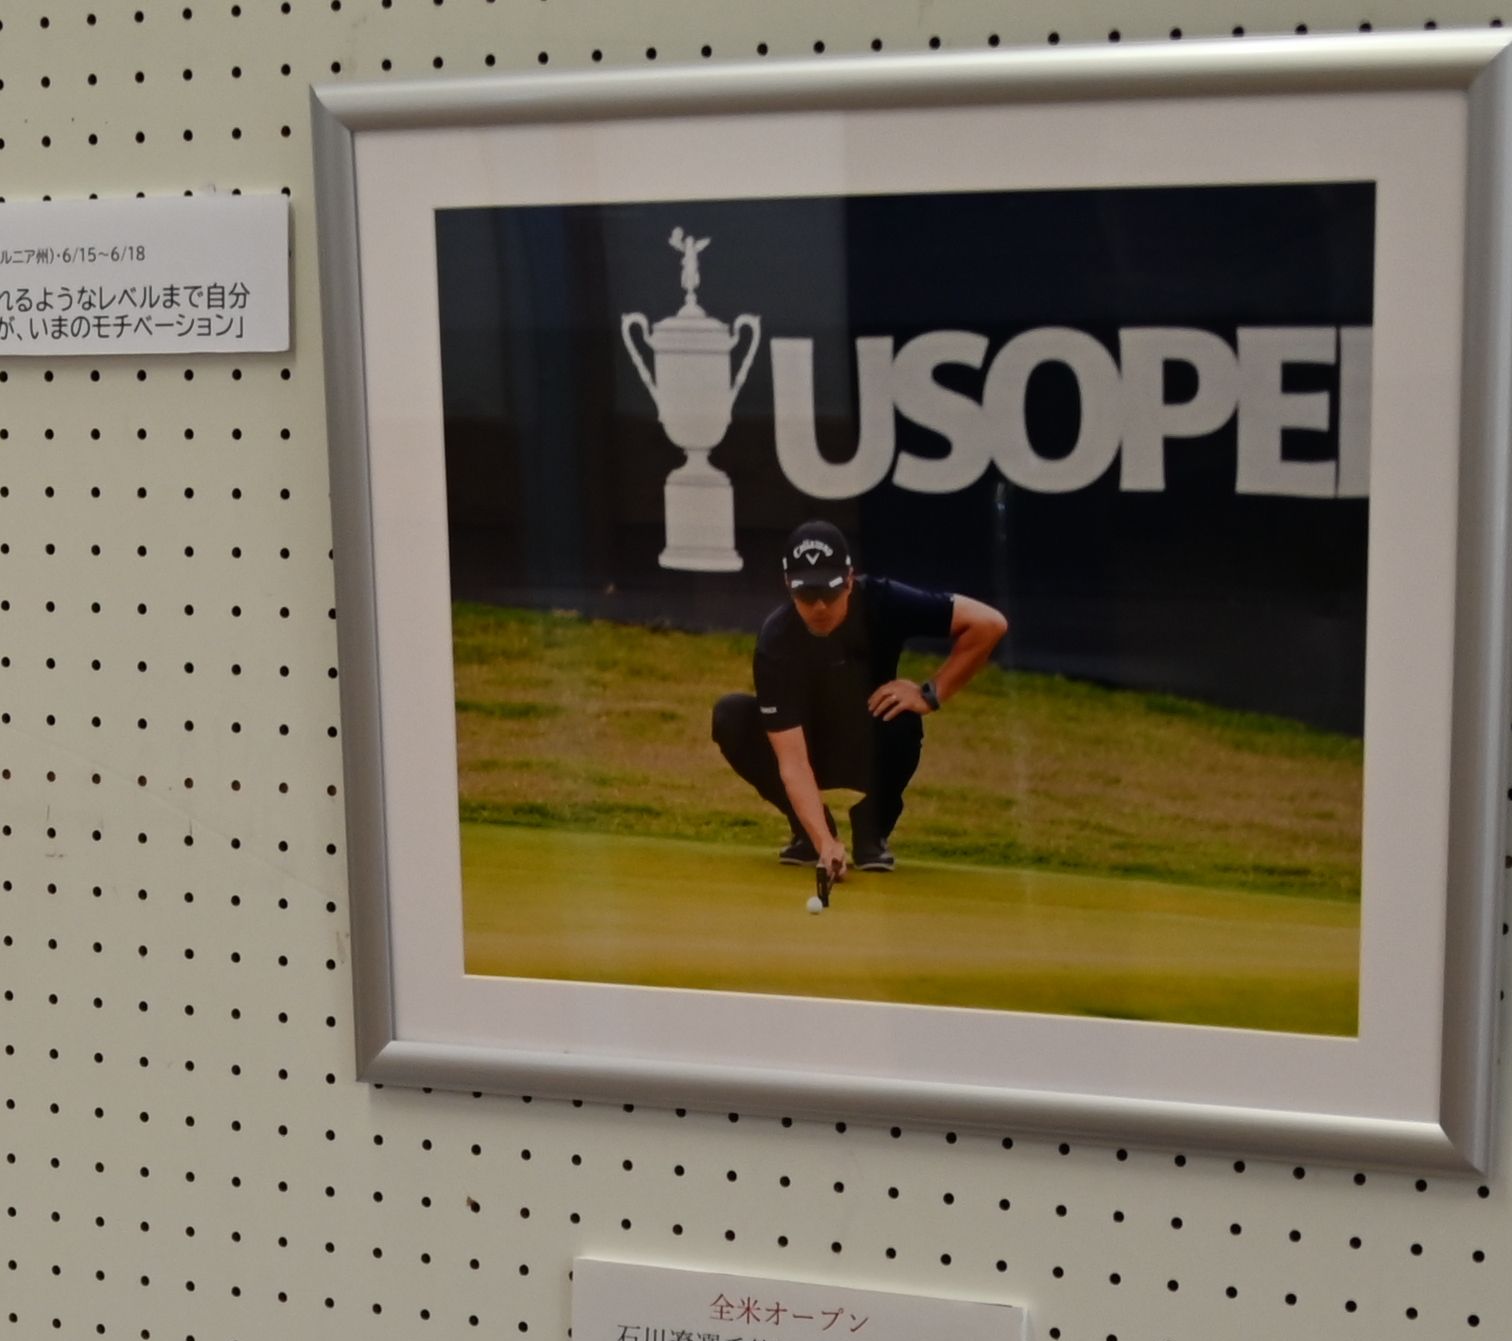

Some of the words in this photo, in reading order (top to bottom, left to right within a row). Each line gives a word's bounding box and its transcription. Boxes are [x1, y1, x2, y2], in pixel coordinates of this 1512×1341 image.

[770, 327, 1371, 500] USOPE
[710, 1292, 871, 1334] 全米オープン
